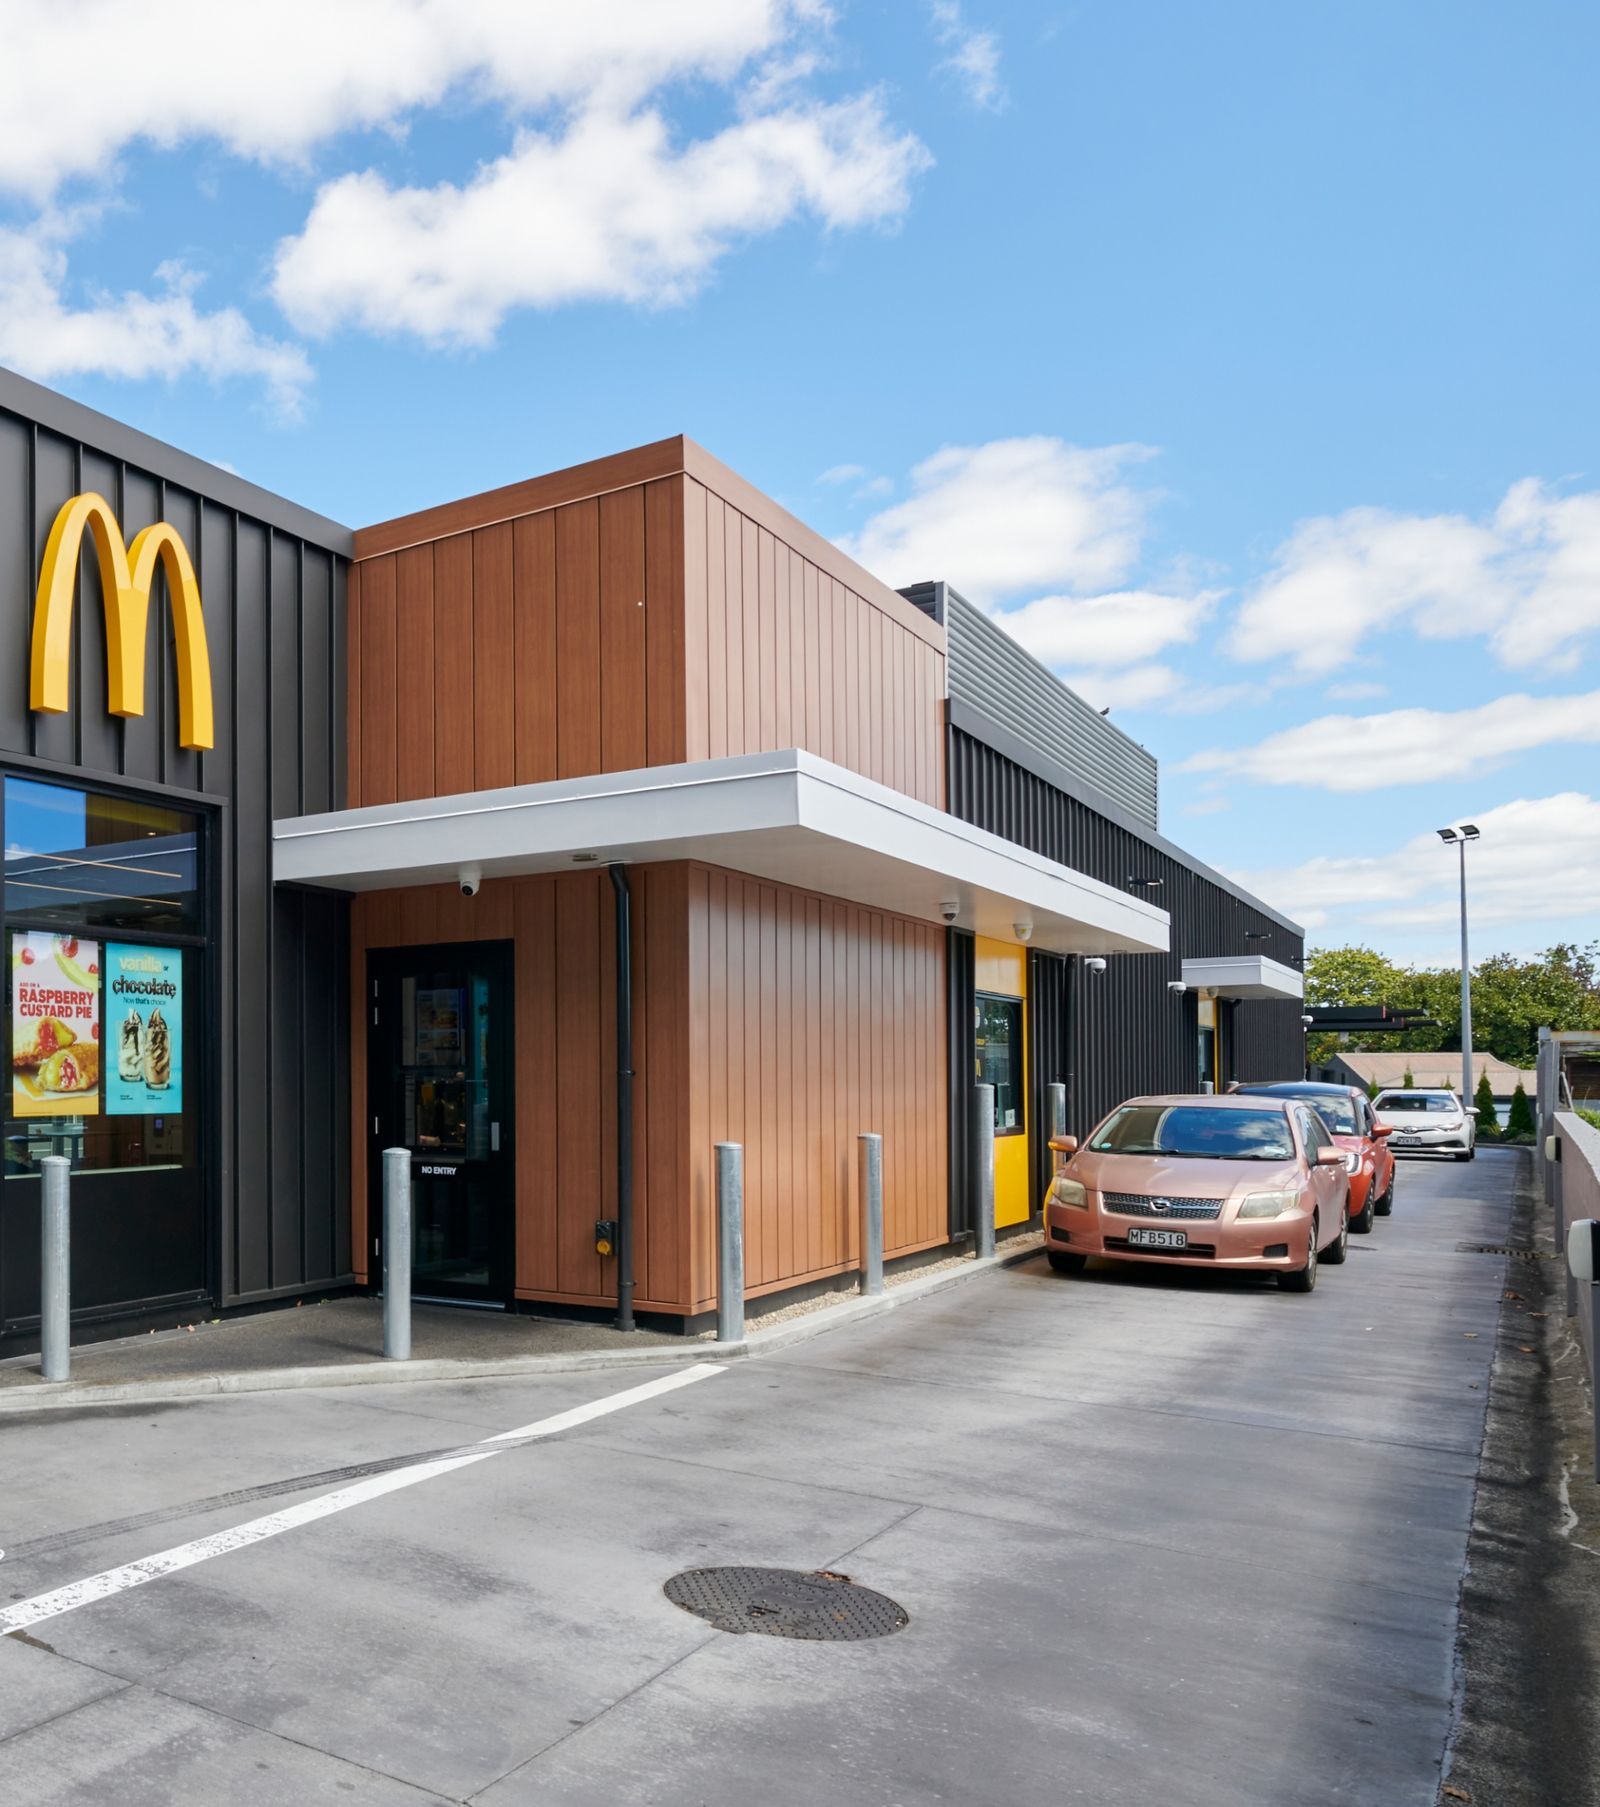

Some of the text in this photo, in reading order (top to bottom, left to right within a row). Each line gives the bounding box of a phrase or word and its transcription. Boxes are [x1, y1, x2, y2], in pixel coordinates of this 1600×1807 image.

[119, 953, 162, 973] vanilla
[112, 974, 176, 999] chocolate
[19, 988, 94, 1005] RASPBERRY
[20, 1003, 92, 1018] CUSTARD PIE
[421, 1166, 457, 1175] NO ENTRY
[1130, 1231, 1185, 1246] MFB518
